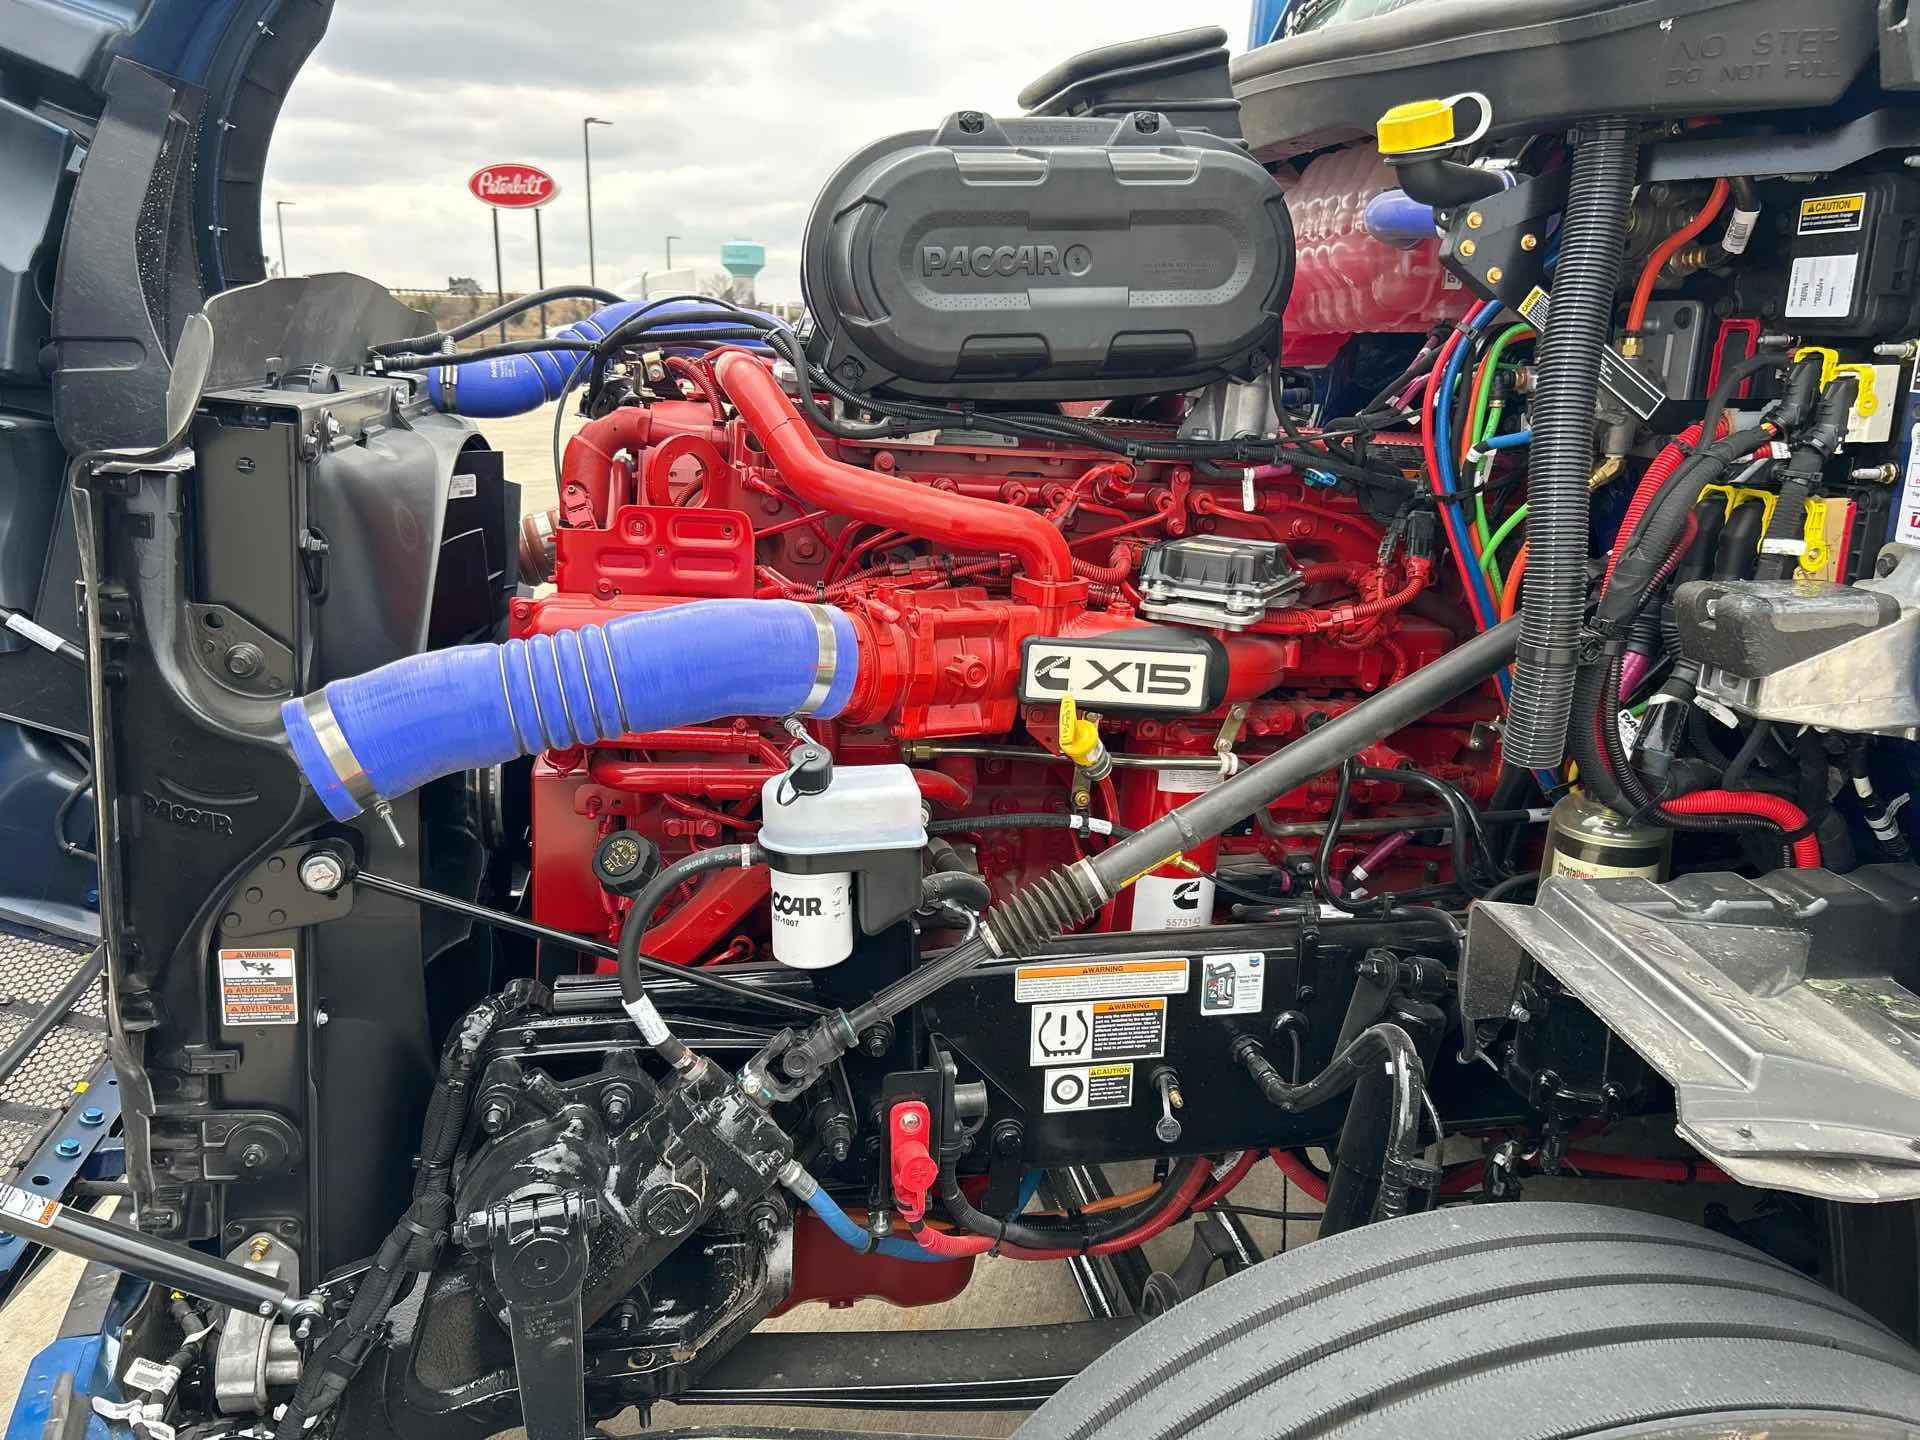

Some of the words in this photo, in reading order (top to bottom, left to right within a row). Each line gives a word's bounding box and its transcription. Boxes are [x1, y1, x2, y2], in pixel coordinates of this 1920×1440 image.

[1677, 33, 1725, 62] NO
[1752, 27, 1841, 56] STEP
[1665, 66, 1702, 86] DO
[1719, 61, 1771, 83] NOT
[1784, 58, 1841, 80] PULL
[478, 172, 549, 197] Peterbilt
[1815, 200, 1851, 212] CAUTION
[922, 245, 1061, 278] PACCAR
[1081, 659, 1192, 696] X15
[1621, 712, 1640, 733] PA
[142, 790, 233, 836] PACCAR
[611, 840, 638, 854] ENGINE
[626, 854, 637, 865] OIL
[1087, 965, 1124, 975] WARNING
[1113, 1002, 1150, 1010] WARNING
[1682, 970, 1790, 1043] STEP
[1096, 1067, 1130, 1075] CAUTION
